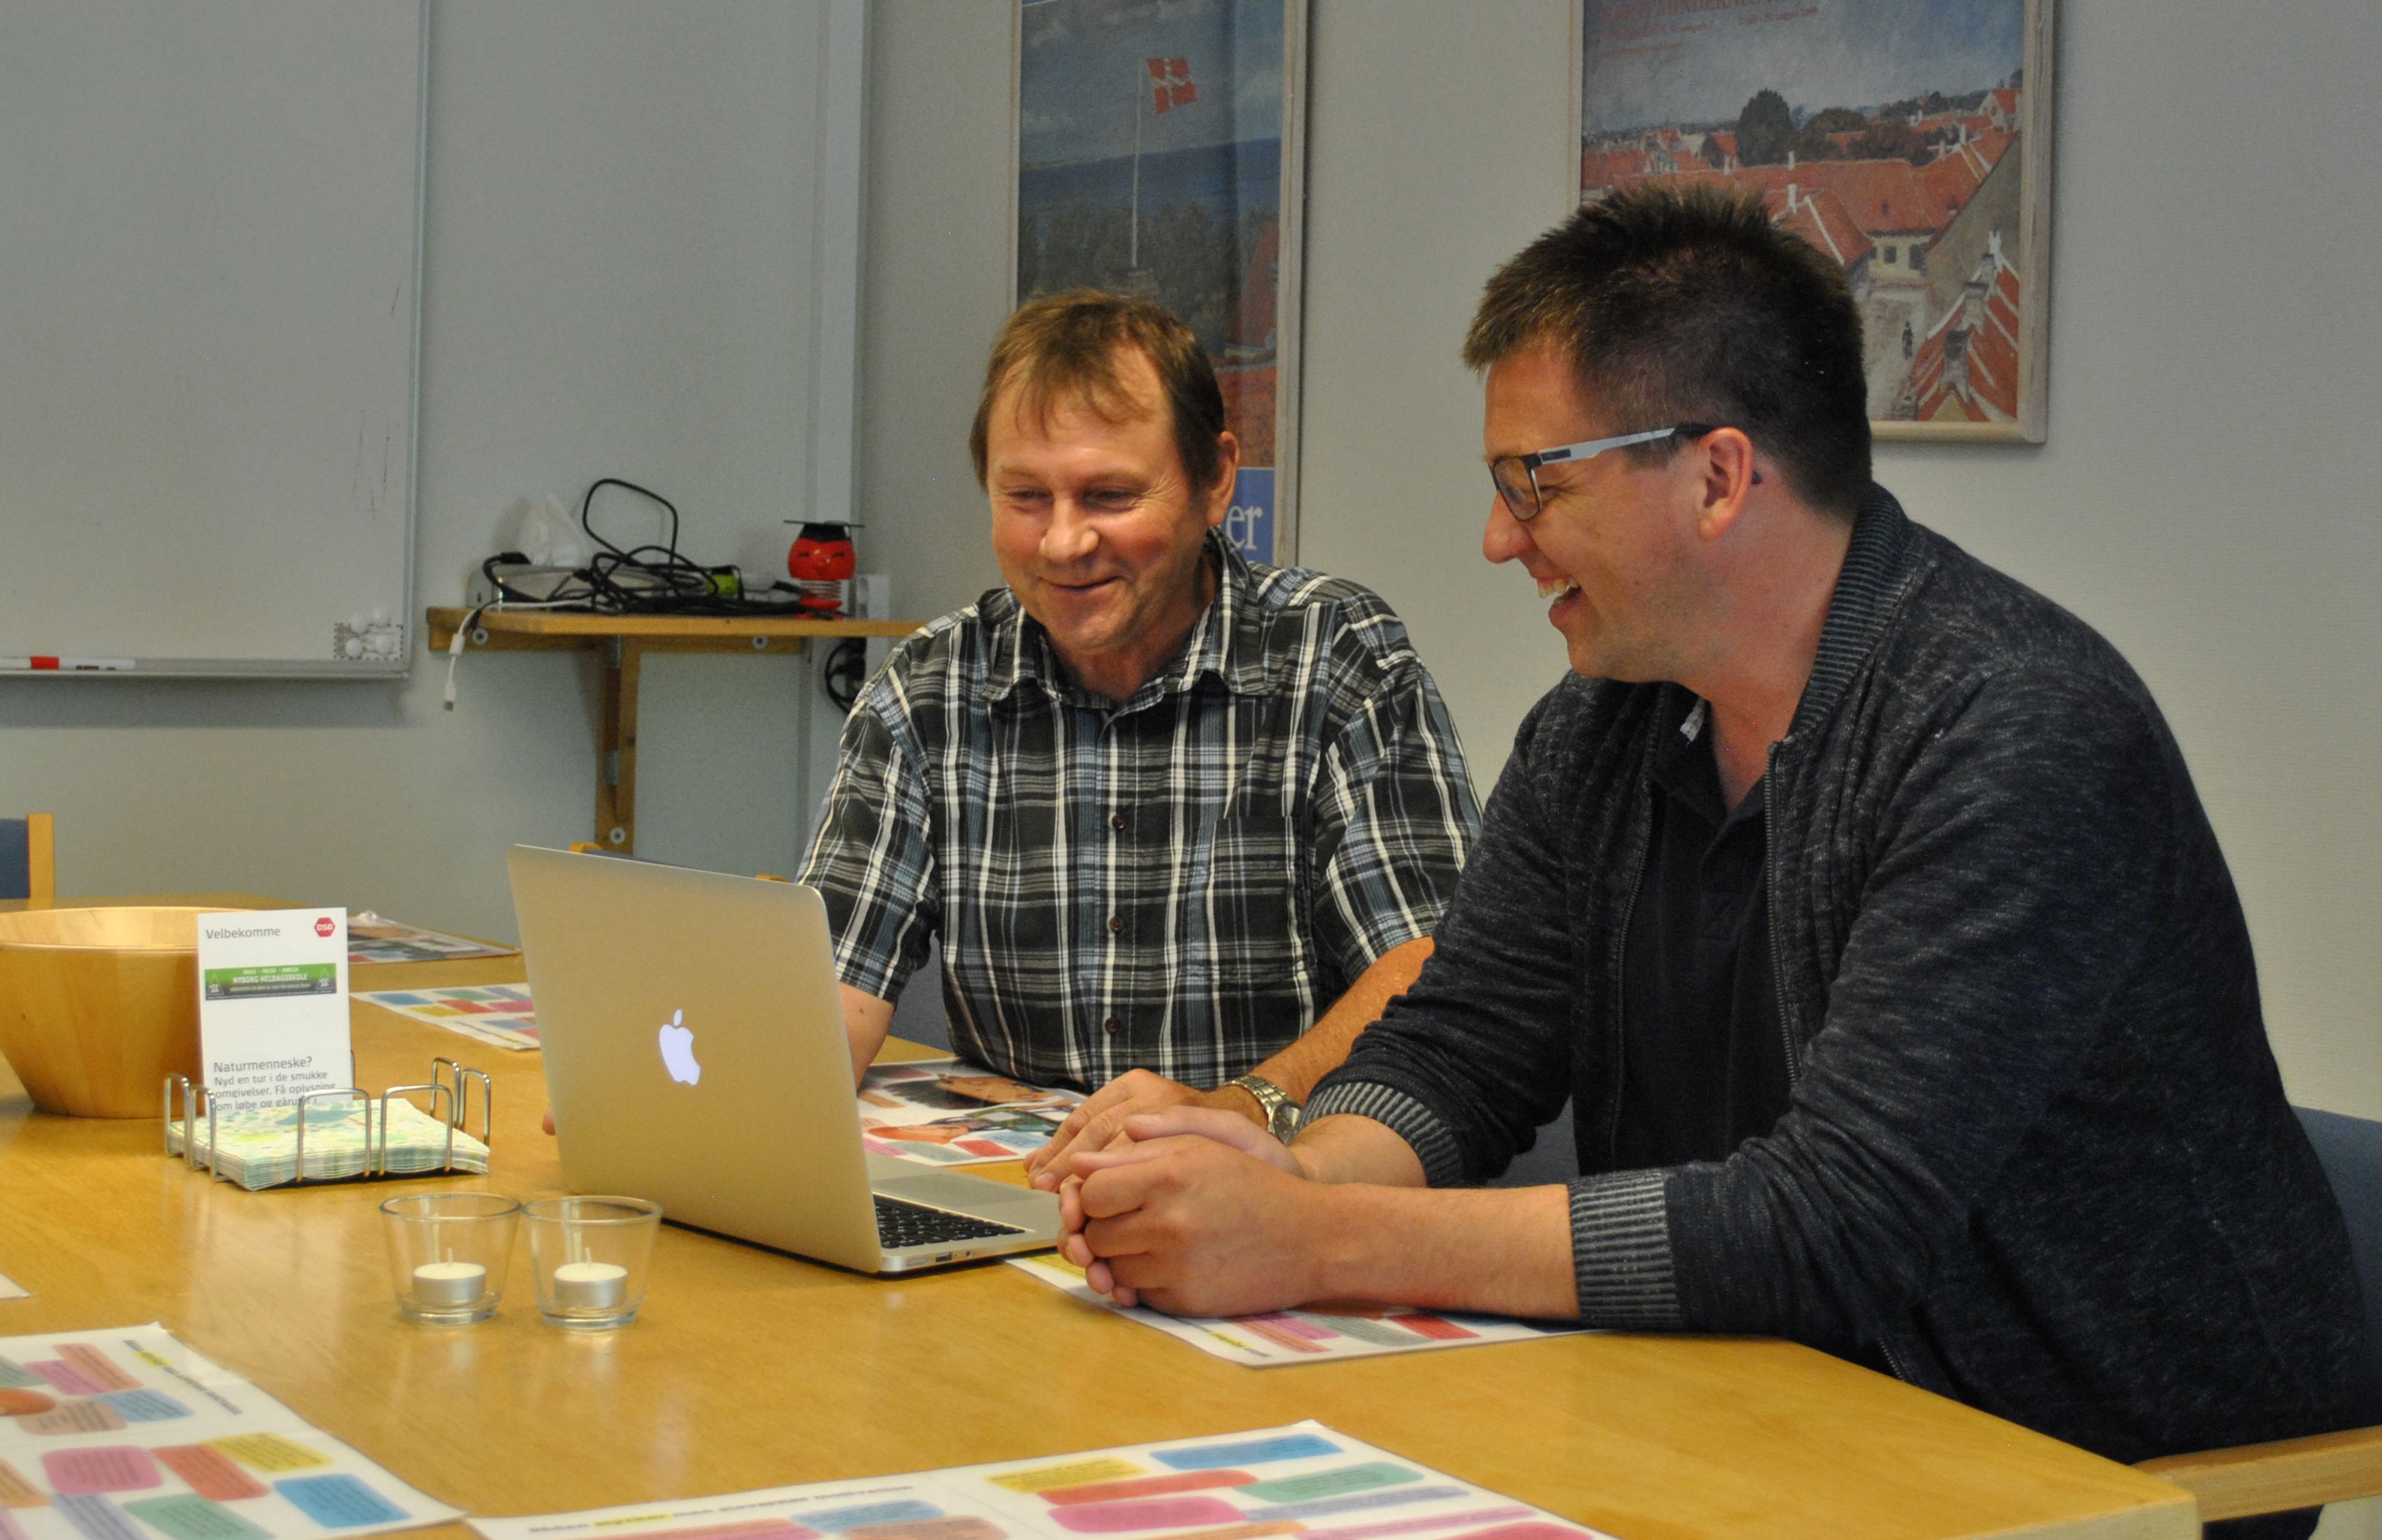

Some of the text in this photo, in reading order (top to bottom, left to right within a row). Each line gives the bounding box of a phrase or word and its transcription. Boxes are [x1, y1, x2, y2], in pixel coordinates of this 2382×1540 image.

[205, 928, 281, 939] Velbekomme
[213, 1056, 313, 1072] Naturmenneske?
[214, 1077, 234, 1087] Nyd
[275, 1073, 288, 1082] de
[290, 1070, 328, 1080] smukke
[215, 1088, 272, 1098] omgivelser.
[275, 1085, 286, 1094] Få
[216, 1103, 233, 1111] om
[235, 1100, 257, 1110] løbe
